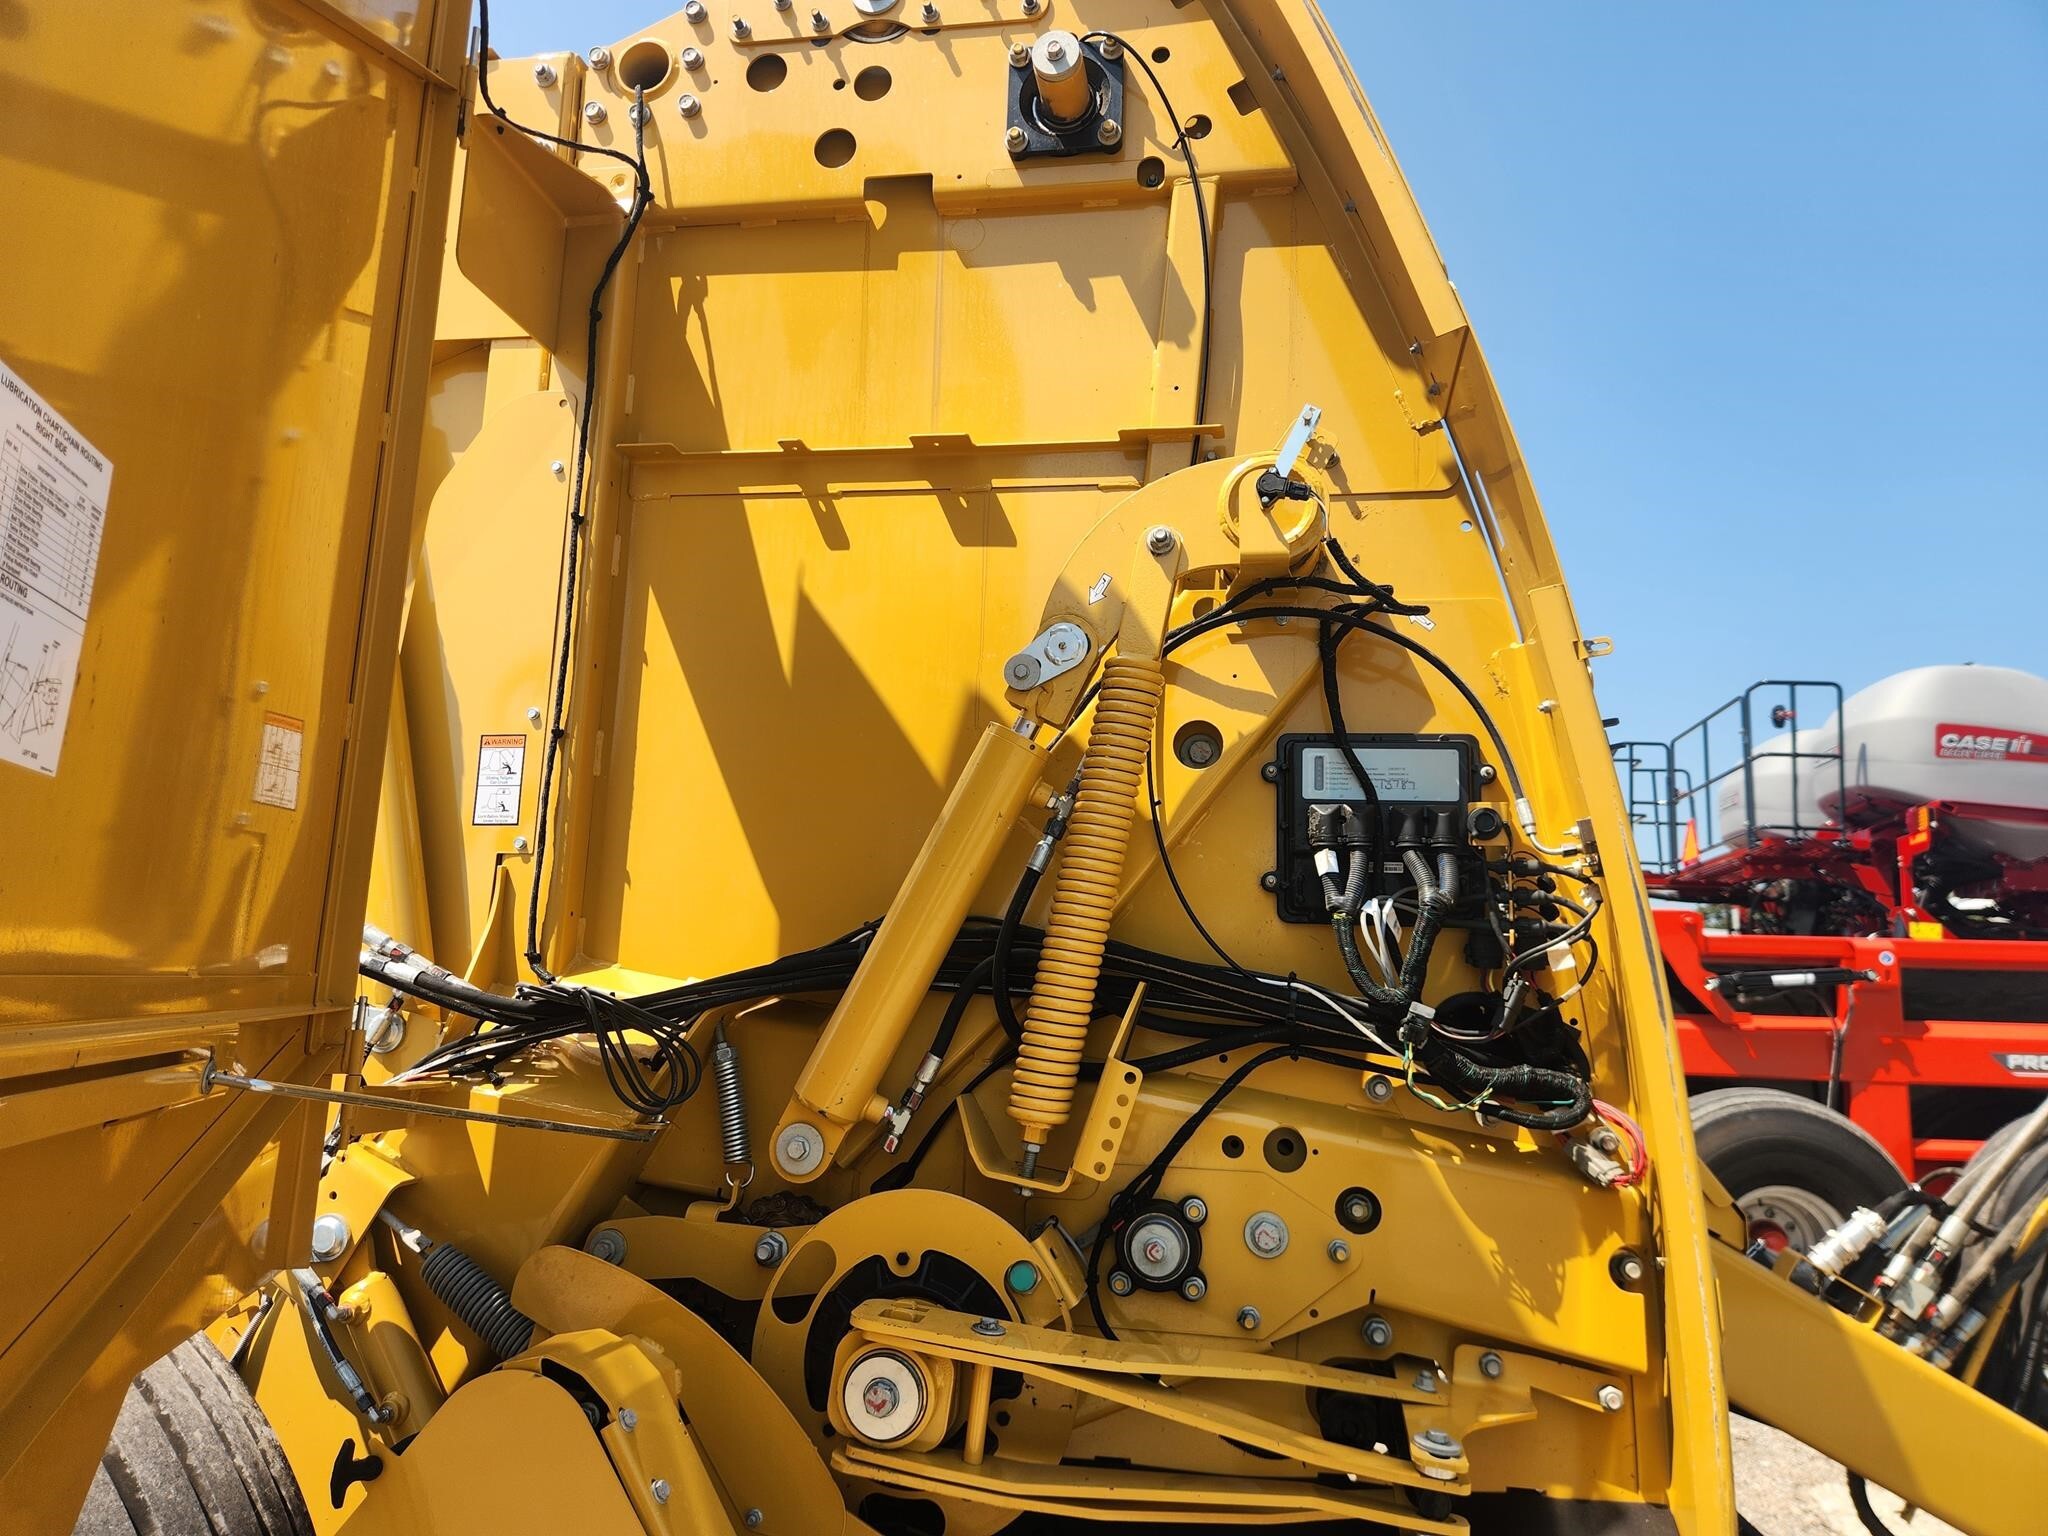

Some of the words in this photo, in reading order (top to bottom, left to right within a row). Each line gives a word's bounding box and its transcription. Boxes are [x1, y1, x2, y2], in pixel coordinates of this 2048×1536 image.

[1, 373, 42, 416] LUBRICATION
[80, 446, 103, 473] ROUTING
[35, 421, 54, 443] RIGHT
[54, 438, 68, 457] SIDE
[1, 575, 28, 599] ROUTING
[1941, 733, 2009, 751] CASE
